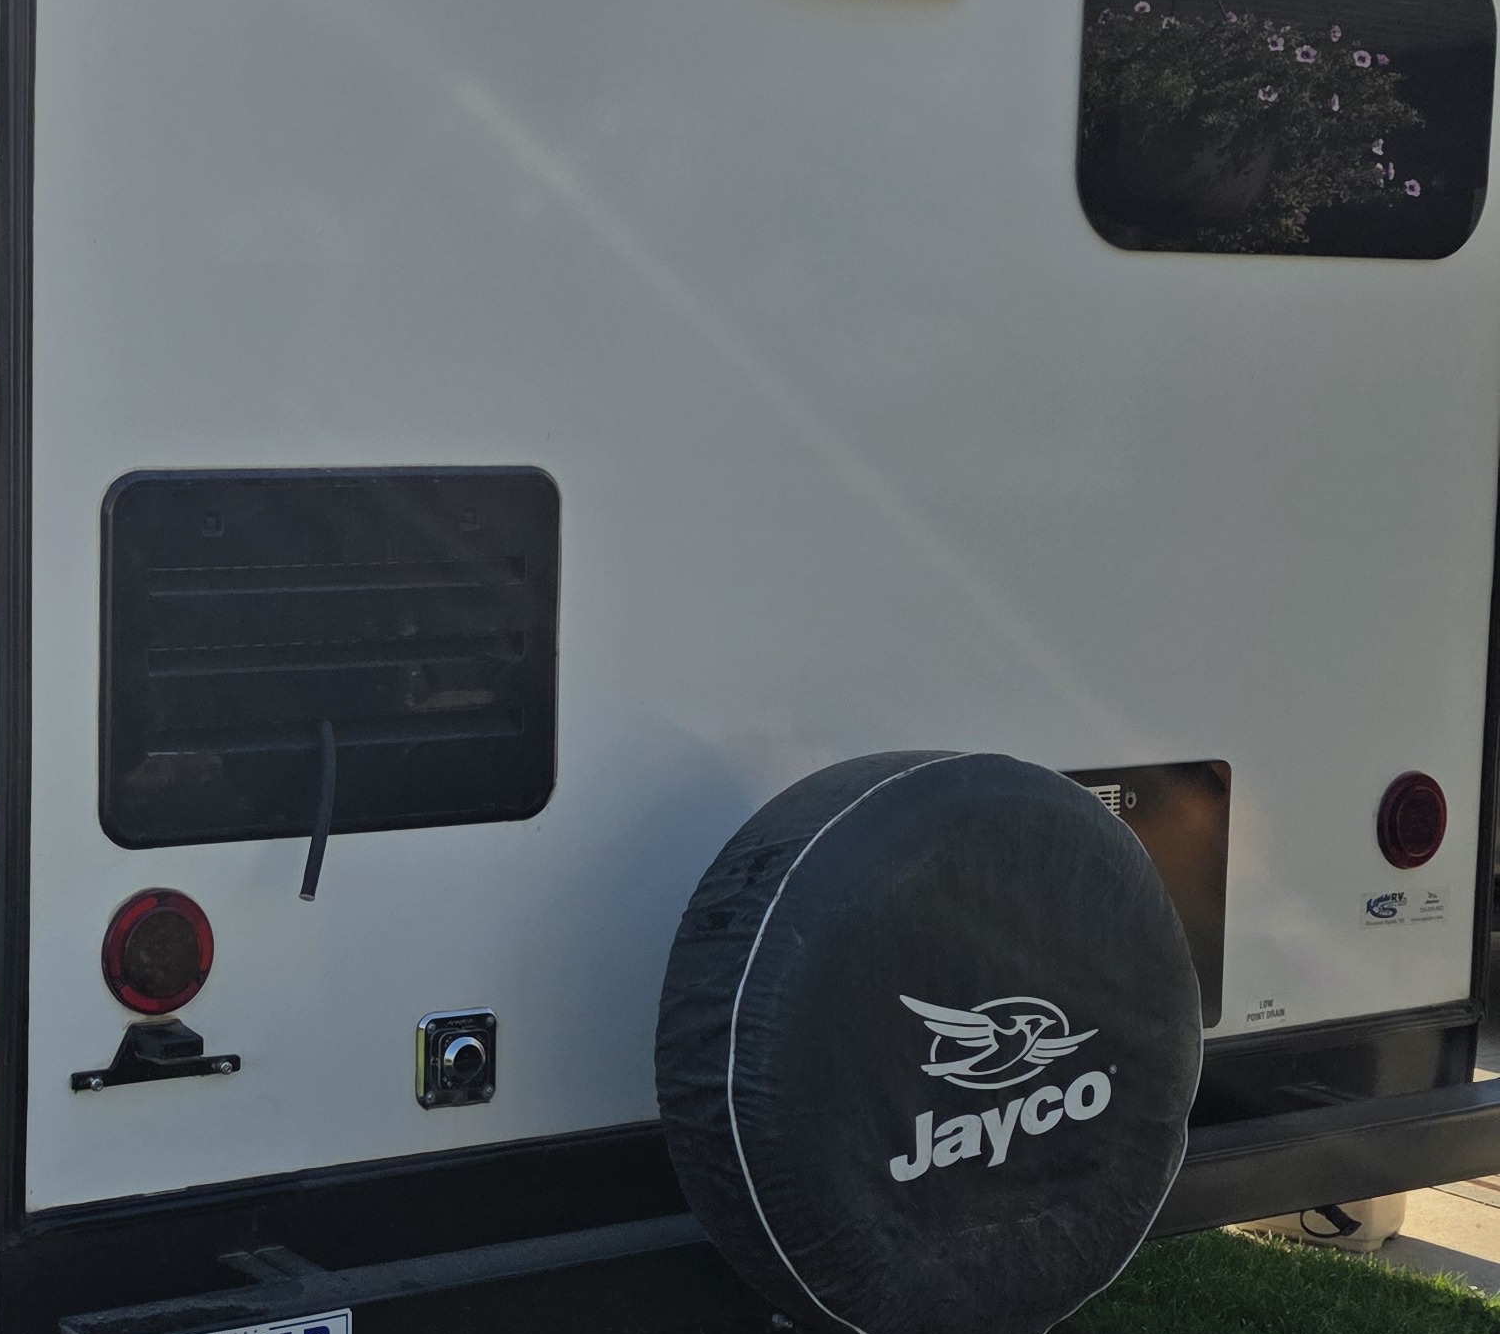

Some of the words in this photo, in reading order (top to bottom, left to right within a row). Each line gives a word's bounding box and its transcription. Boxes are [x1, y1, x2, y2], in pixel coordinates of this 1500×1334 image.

[1259, 999, 1274, 1010] LOW
[1246, 1011, 1265, 1022] POINT
[1266, 1008, 1285, 1019] DRAIN
[890, 1071, 1112, 1182] Jayco
